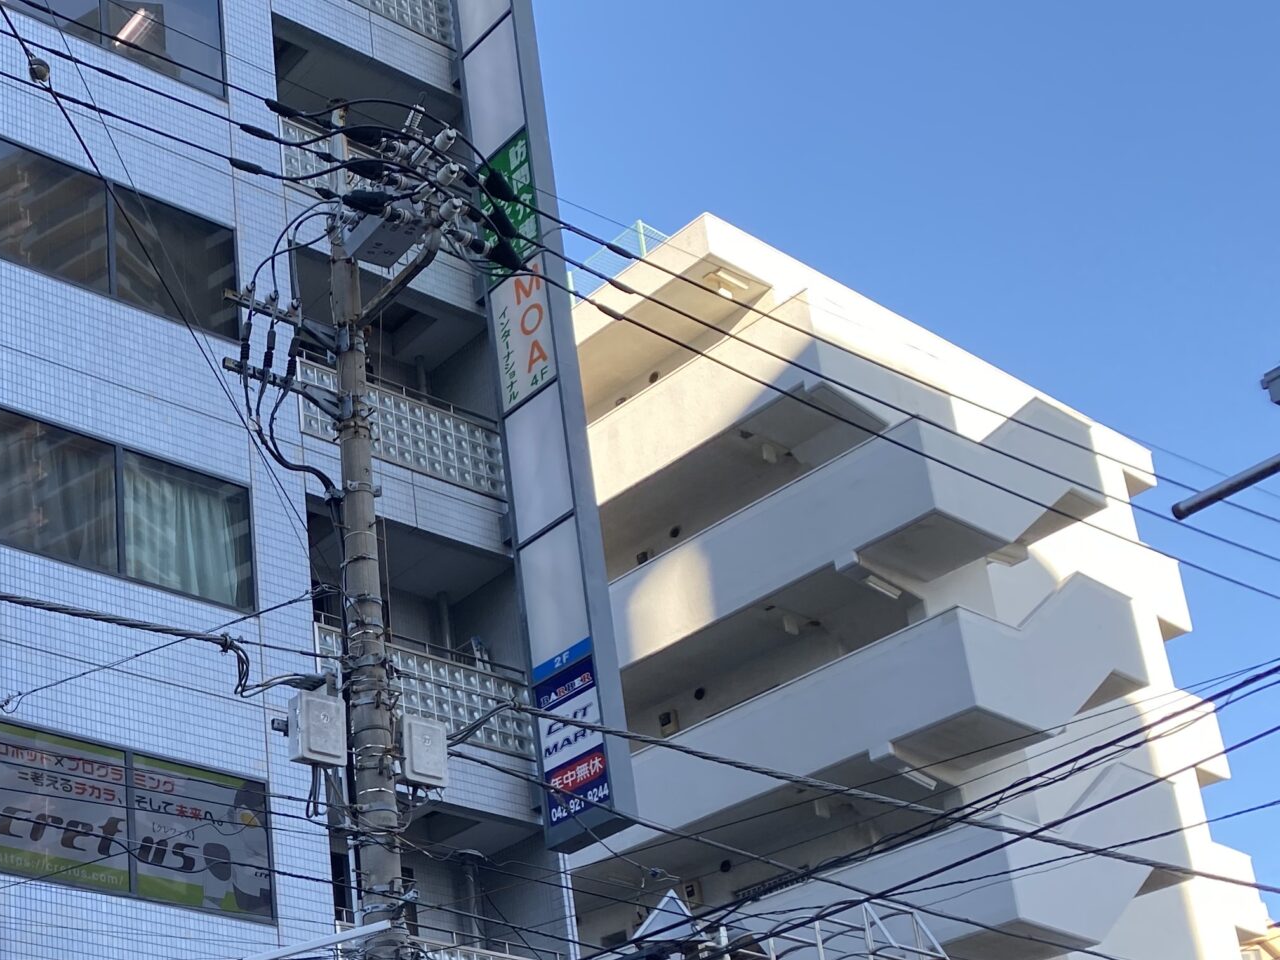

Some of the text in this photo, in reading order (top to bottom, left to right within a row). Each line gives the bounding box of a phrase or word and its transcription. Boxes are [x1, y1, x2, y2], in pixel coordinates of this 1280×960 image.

[514, 262, 547, 374] MOA
[498, 306, 519, 404] インターナショナル
[530, 365, 548, 387] 4F
[554, 651, 570, 668] 2F
[540, 672, 593, 707] BARBER
[550, 756, 603, 792] 年中無休
